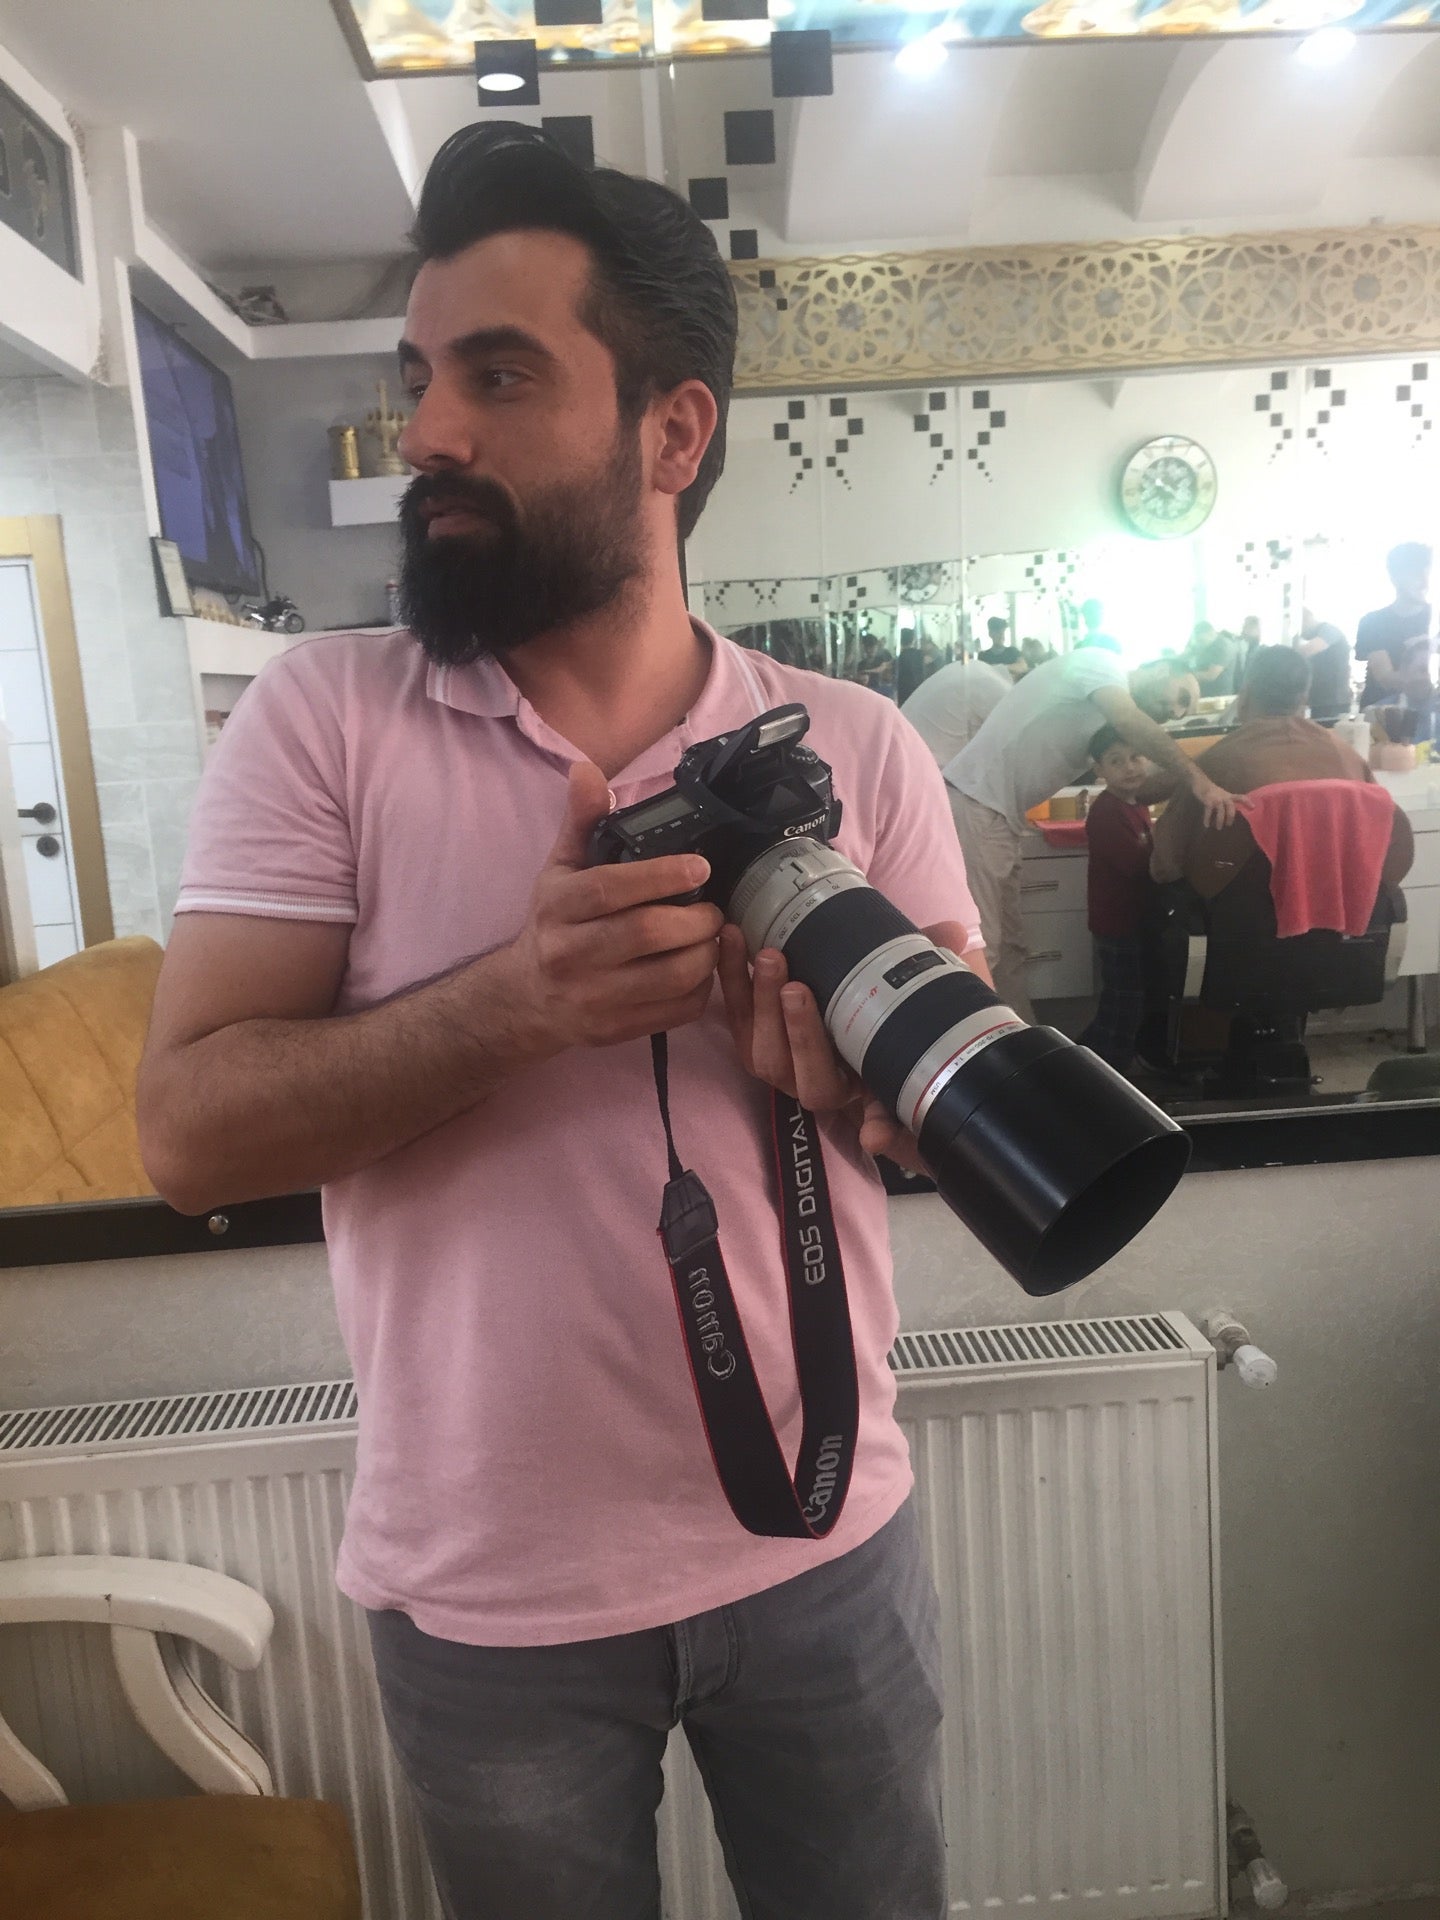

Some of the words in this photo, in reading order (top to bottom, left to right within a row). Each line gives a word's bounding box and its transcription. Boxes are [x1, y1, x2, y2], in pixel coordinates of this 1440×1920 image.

[783, 813, 827, 837] Canon
[805, 897, 817, 907] 100
[790, 912, 800, 923] 135
[800, 1225, 826, 1286] EOS
[802, 1435, 843, 1524] Canon
